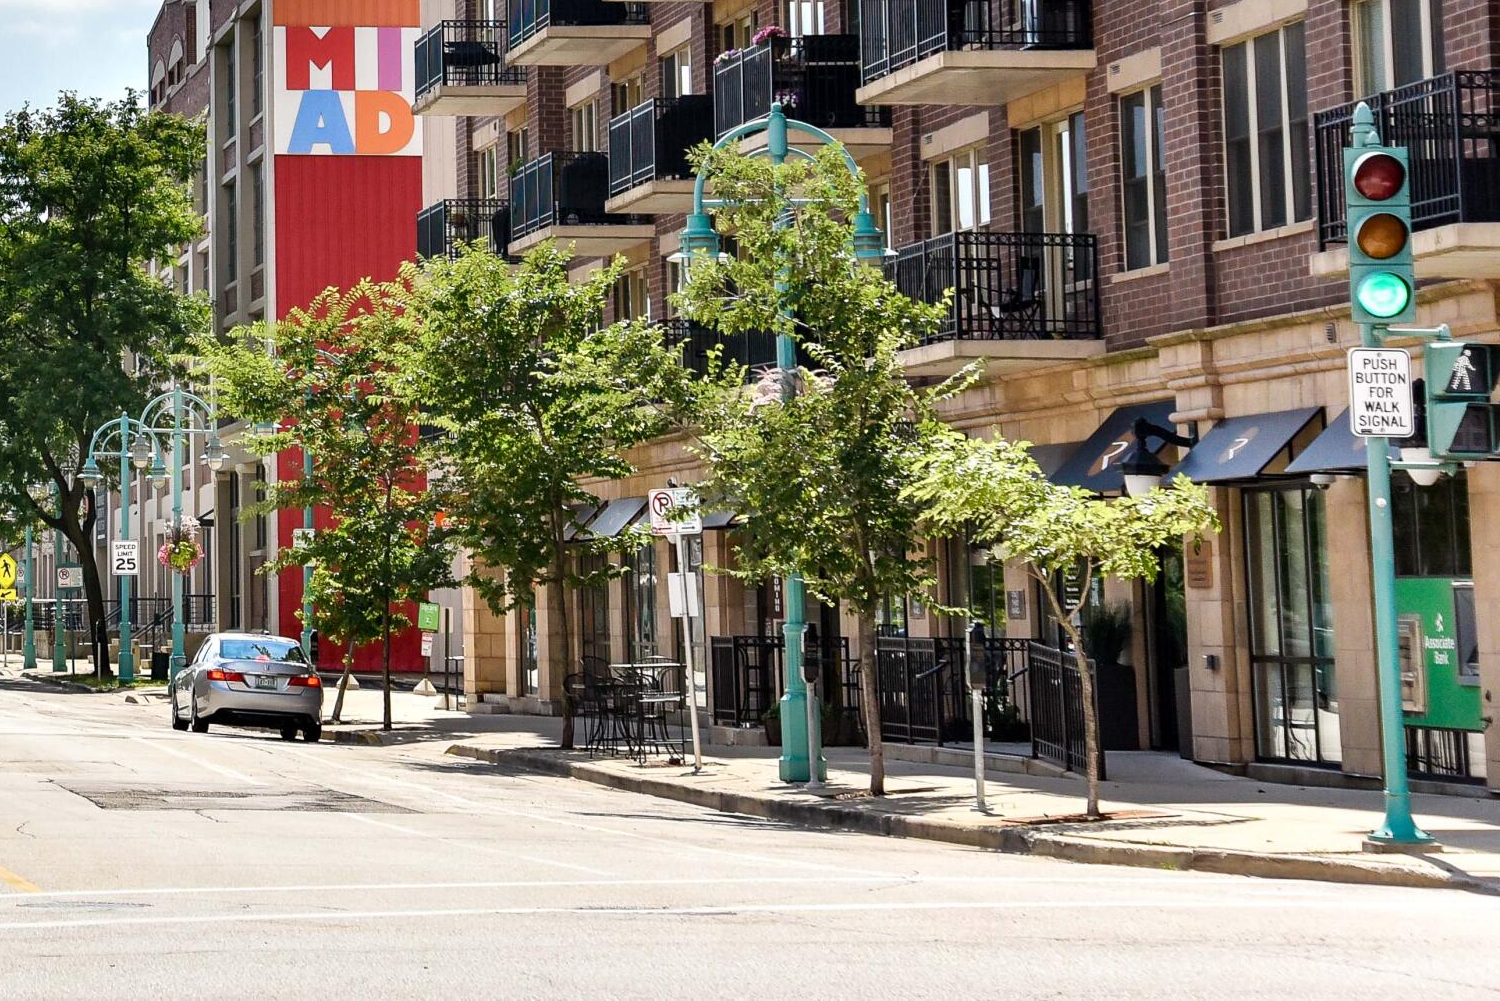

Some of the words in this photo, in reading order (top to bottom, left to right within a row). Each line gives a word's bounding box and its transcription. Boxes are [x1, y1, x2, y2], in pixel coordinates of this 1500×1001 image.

[1363, 358, 1397, 370] PUSH
[1356, 372, 1406, 384] BUTTON
[1369, 386, 1393, 398] FOR
[1364, 401, 1400, 413] WALK
[1359, 415, 1407, 427] SIGNAL
[116, 558, 136, 570] 25
[1424, 635, 1455, 649] Associate
[1434, 651, 1450, 665] Bank
